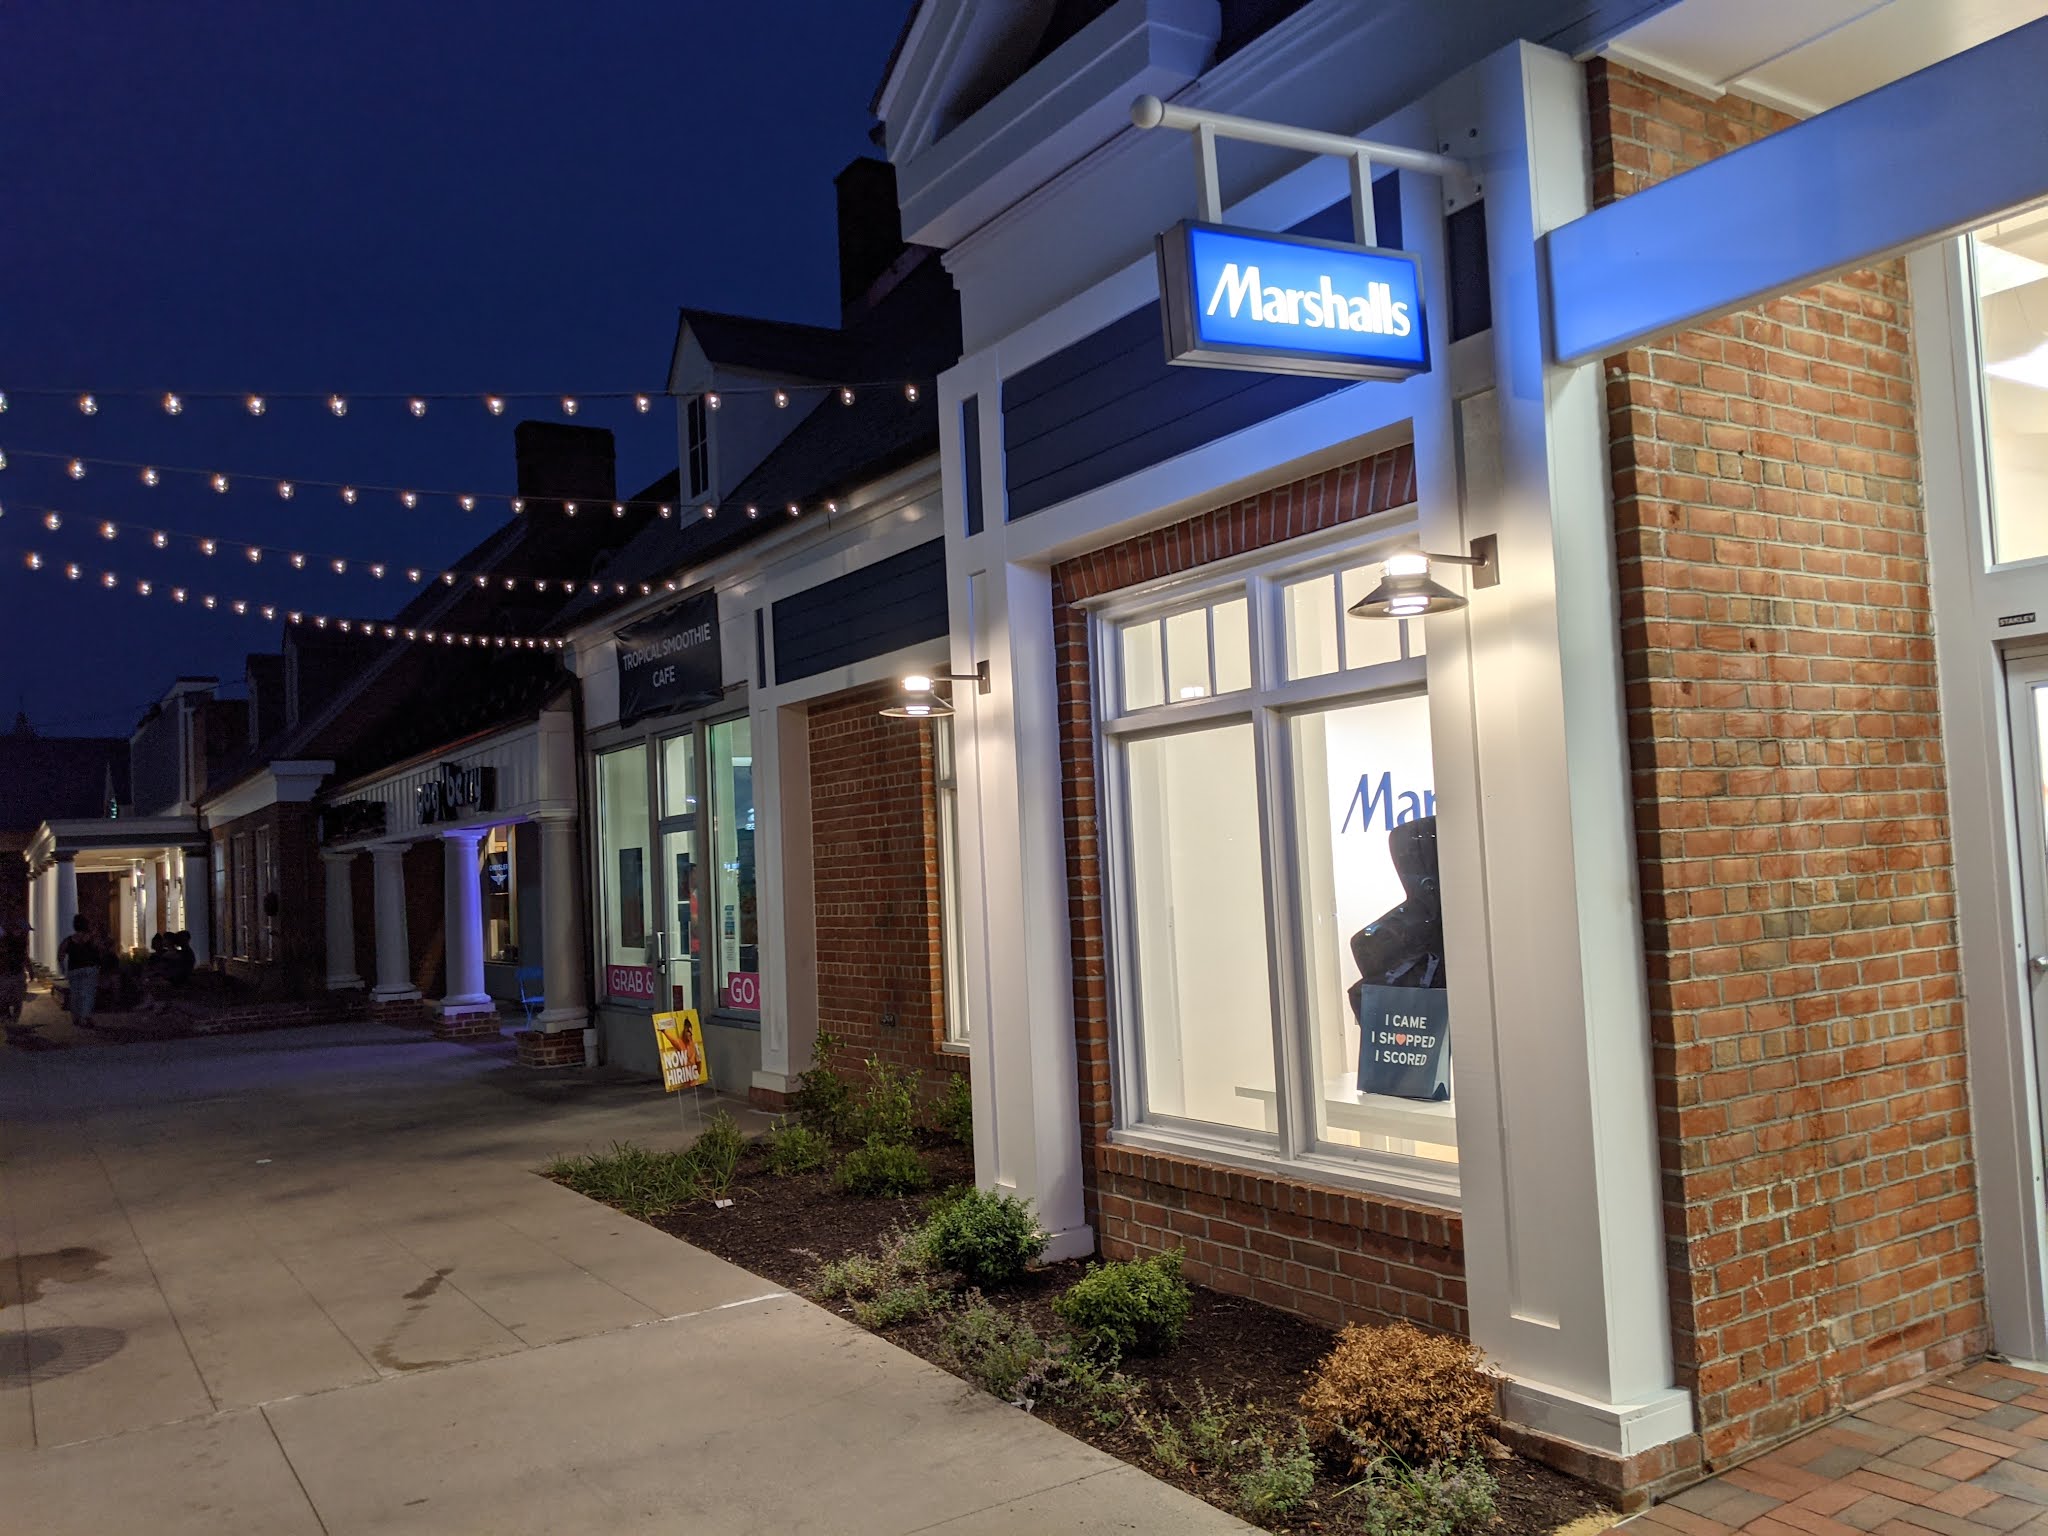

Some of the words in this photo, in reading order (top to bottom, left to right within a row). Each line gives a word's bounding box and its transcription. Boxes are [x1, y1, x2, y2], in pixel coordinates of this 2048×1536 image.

[1207, 263, 1411, 337] Marshalls
[622, 641, 662, 671] TROPICAL
[662, 623, 711, 656] SMOOTHIE
[652, 665, 676, 688] CAFE
[612, 969, 643, 993] GRAB
[645, 971, 654, 994] &
[731, 977, 755, 1004] GO
[1385, 1014, 1389, 1026] I
[1392, 1014, 1427, 1029] CAME
[1371, 1031, 1375, 1043] I
[663, 1049, 688, 1070] NOW
[1375, 1050, 1379, 1062] I
[1383, 1050, 1427, 1066] SCORED
[666, 1064, 700, 1087] HIRING
